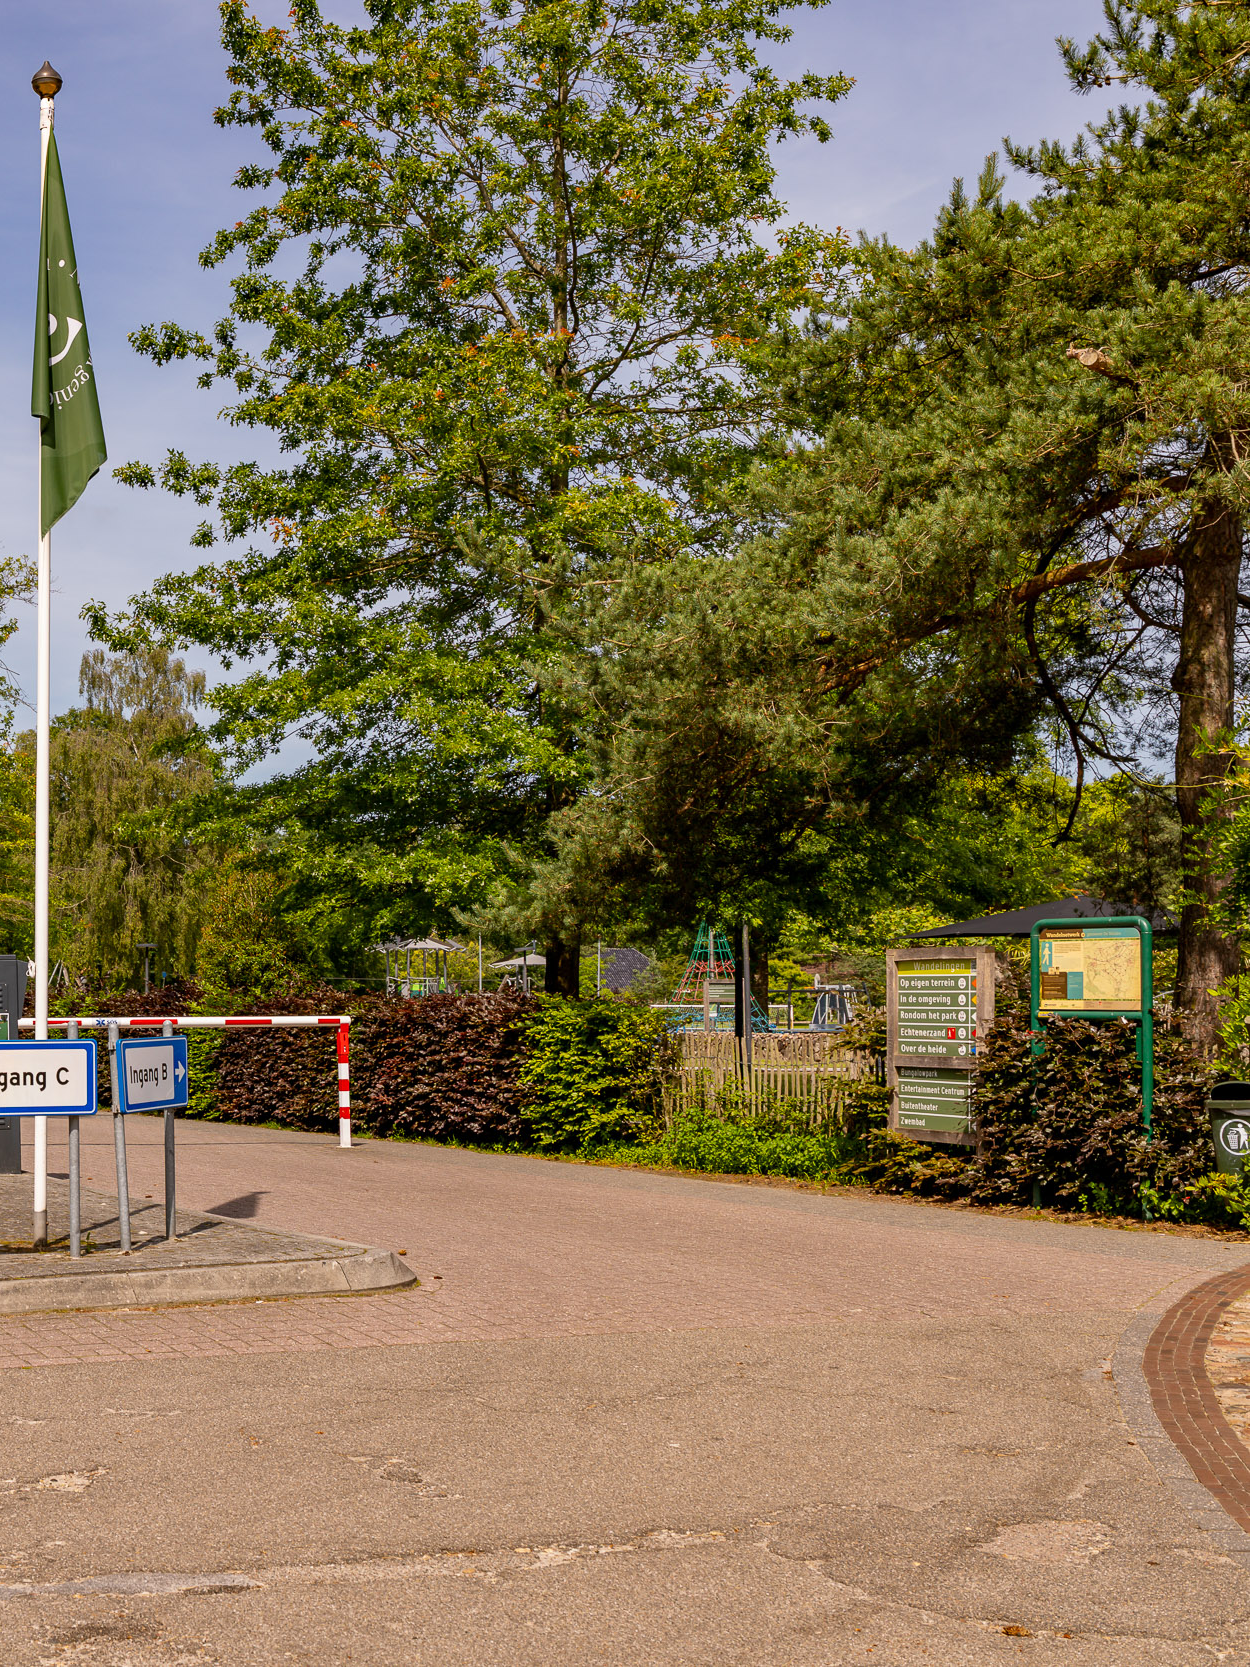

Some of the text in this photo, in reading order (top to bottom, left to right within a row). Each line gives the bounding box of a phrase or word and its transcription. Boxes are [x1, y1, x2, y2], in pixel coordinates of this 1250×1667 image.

[913, 961, 965, 973] Wandelingen
[900, 979, 909, 988] Op
[911, 979, 929, 988] eigen
[908, 995, 917, 1003] de
[918, 995, 951, 1005] omgeving
[900, 1011, 927, 1019] Rondom
[928, 1011, 940, 1019] het
[941, 1012, 957, 1021] park
[900, 1028, 946, 1037] Echtenerzand
[901, 1044, 947, 1054] Over de heide
[56, 1067, 70, 1085] C
[129, 1063, 168, 1088] Ingang B
[900, 1068, 938, 1078] Bungalowpark
[901, 1084, 965, 1096] Entertainment Centrum
[900, 1101, 938, 1111] Buitentheater
[900, 1117, 926, 1126] Zwembad
